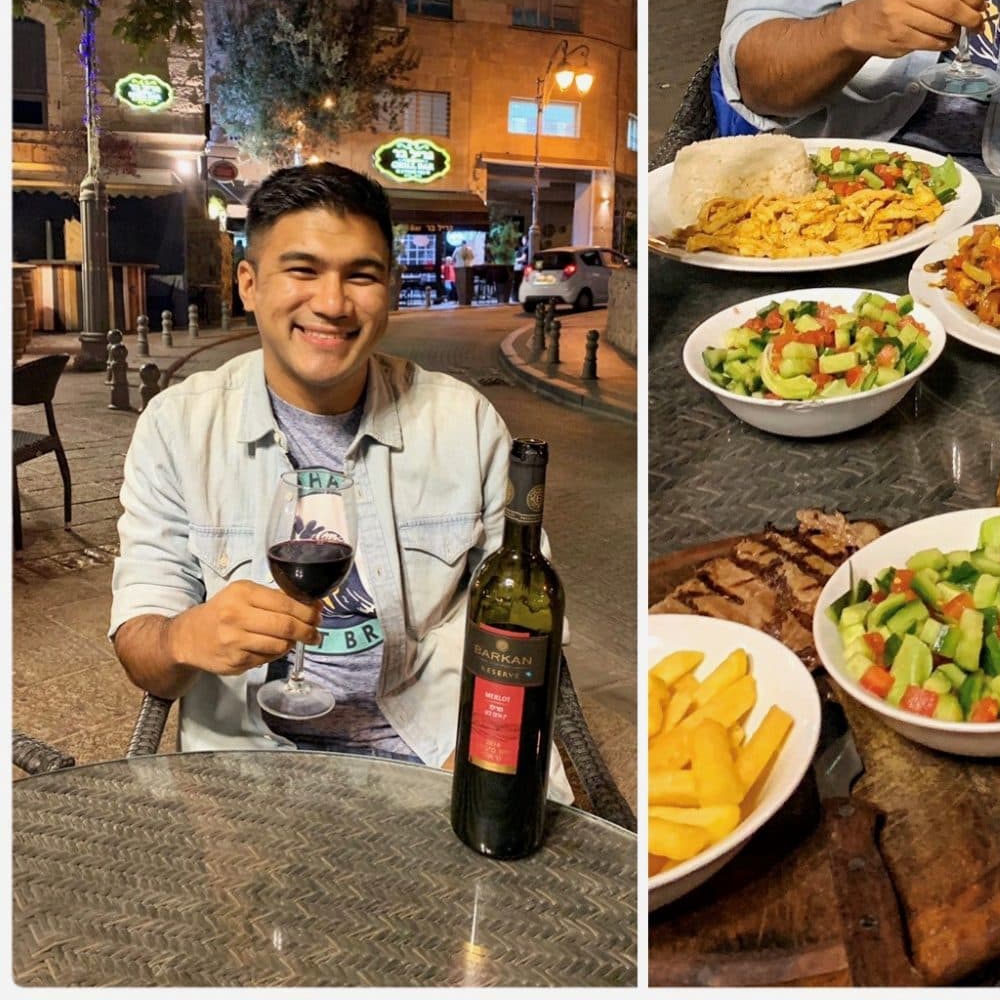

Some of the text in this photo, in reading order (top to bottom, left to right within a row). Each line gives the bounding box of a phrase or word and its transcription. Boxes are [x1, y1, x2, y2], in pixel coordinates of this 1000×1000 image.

[297, 471, 340, 489] HA
[344, 624, 380, 650] BR
[474, 643, 533, 665] BARKAN
[481, 665, 520, 679] RESERVE
[485, 692, 511, 702] MERLOT
